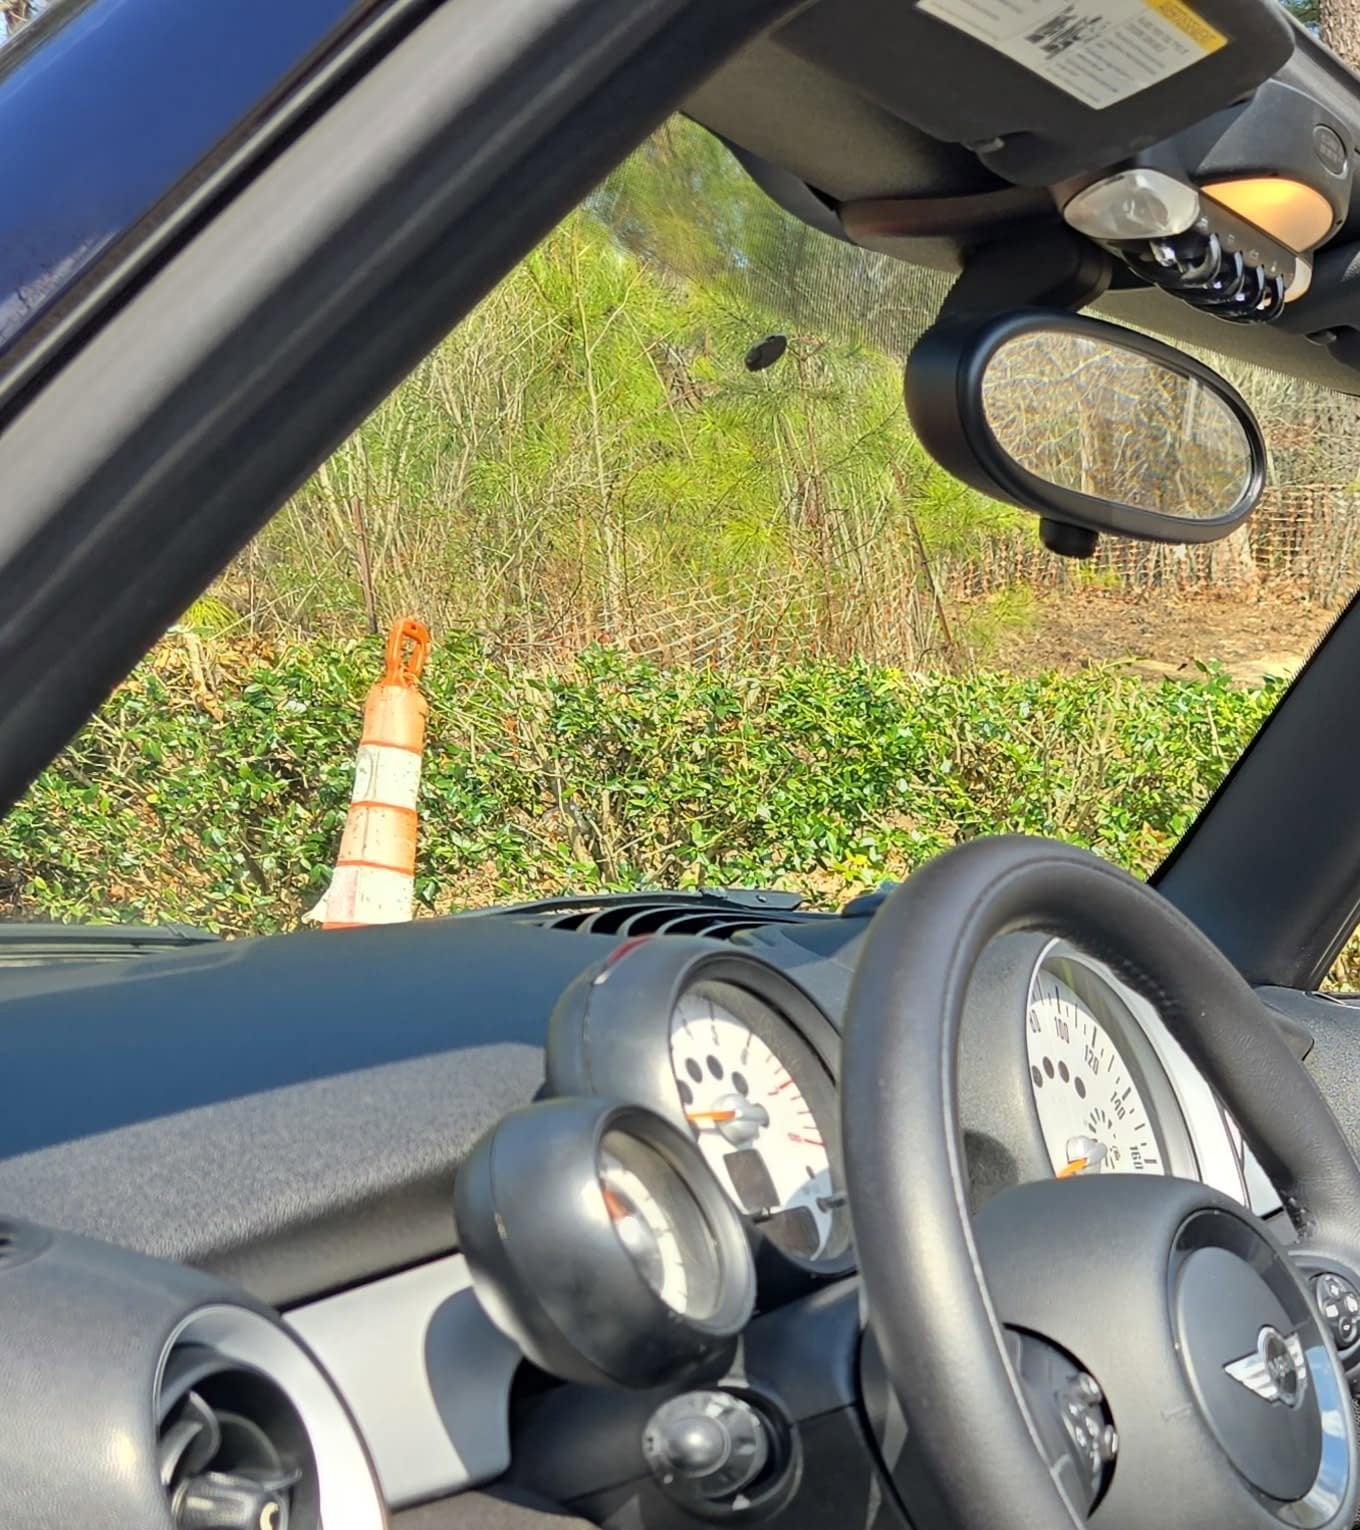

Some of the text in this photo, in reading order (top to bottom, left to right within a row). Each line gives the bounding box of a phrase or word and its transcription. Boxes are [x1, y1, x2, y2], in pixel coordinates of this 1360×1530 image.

[1084, 1044, 1099, 1075] 120
[1110, 1091, 1126, 1120] 140
[1130, 1145, 1144, 1170] 160
